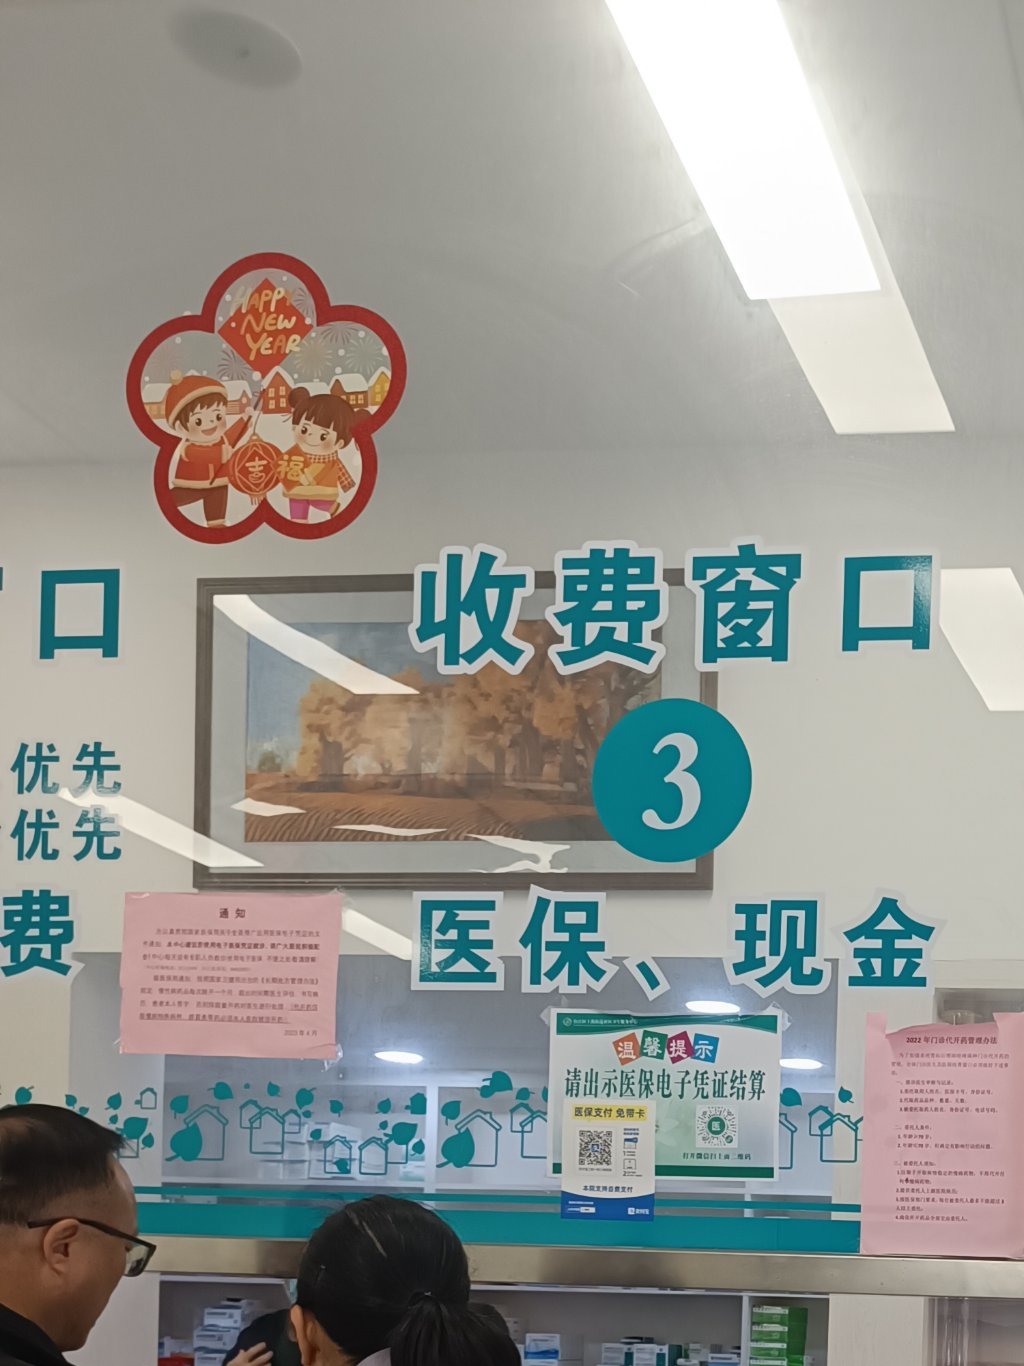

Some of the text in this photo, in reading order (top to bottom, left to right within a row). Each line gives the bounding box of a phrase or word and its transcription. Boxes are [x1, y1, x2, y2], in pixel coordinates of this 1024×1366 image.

[230, 286, 294, 316] HAPPY
[240, 313, 297, 335] NEW
[245, 334, 301, 360] YEAR
[277, 454, 305, 481] 福
[0, 566, 121, 660] 口
[415, 543, 933, 667] 收费窗口
[9, 741, 122, 795] 优先
[641, 731, 701, 830] 3
[9, 806, 122, 862] 优先
[219, 907, 246, 919] 通知
[0, 889, 75, 977] 费
[418, 896, 935, 992] 医保、现金
[617, 1036, 714, 1060] 温馨提示
[564, 1067, 766, 1101] 请出示医保电子凭证结算
[574, 1106, 646, 1119] 医保支付 免带卡
